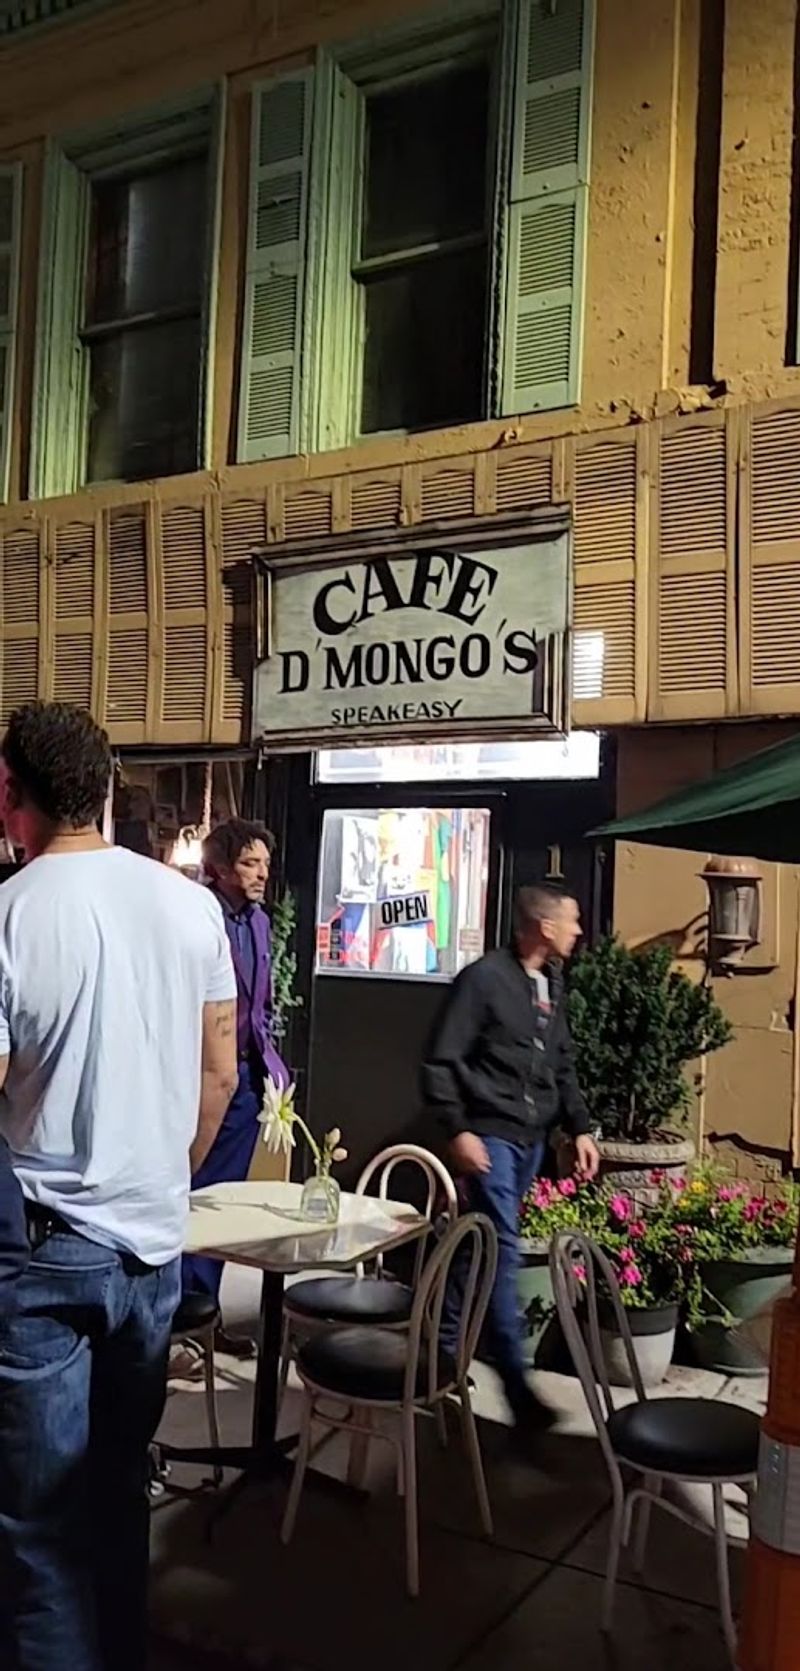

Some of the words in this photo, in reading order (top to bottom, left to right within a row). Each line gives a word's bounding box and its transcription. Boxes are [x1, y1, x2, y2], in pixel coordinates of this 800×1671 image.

[313, 551, 498, 635] CAFE
[277, 618, 539, 694] D'MONGO'S
[331, 699, 463, 725] SPEAKEASY
[381, 894, 428, 925] OPEN
